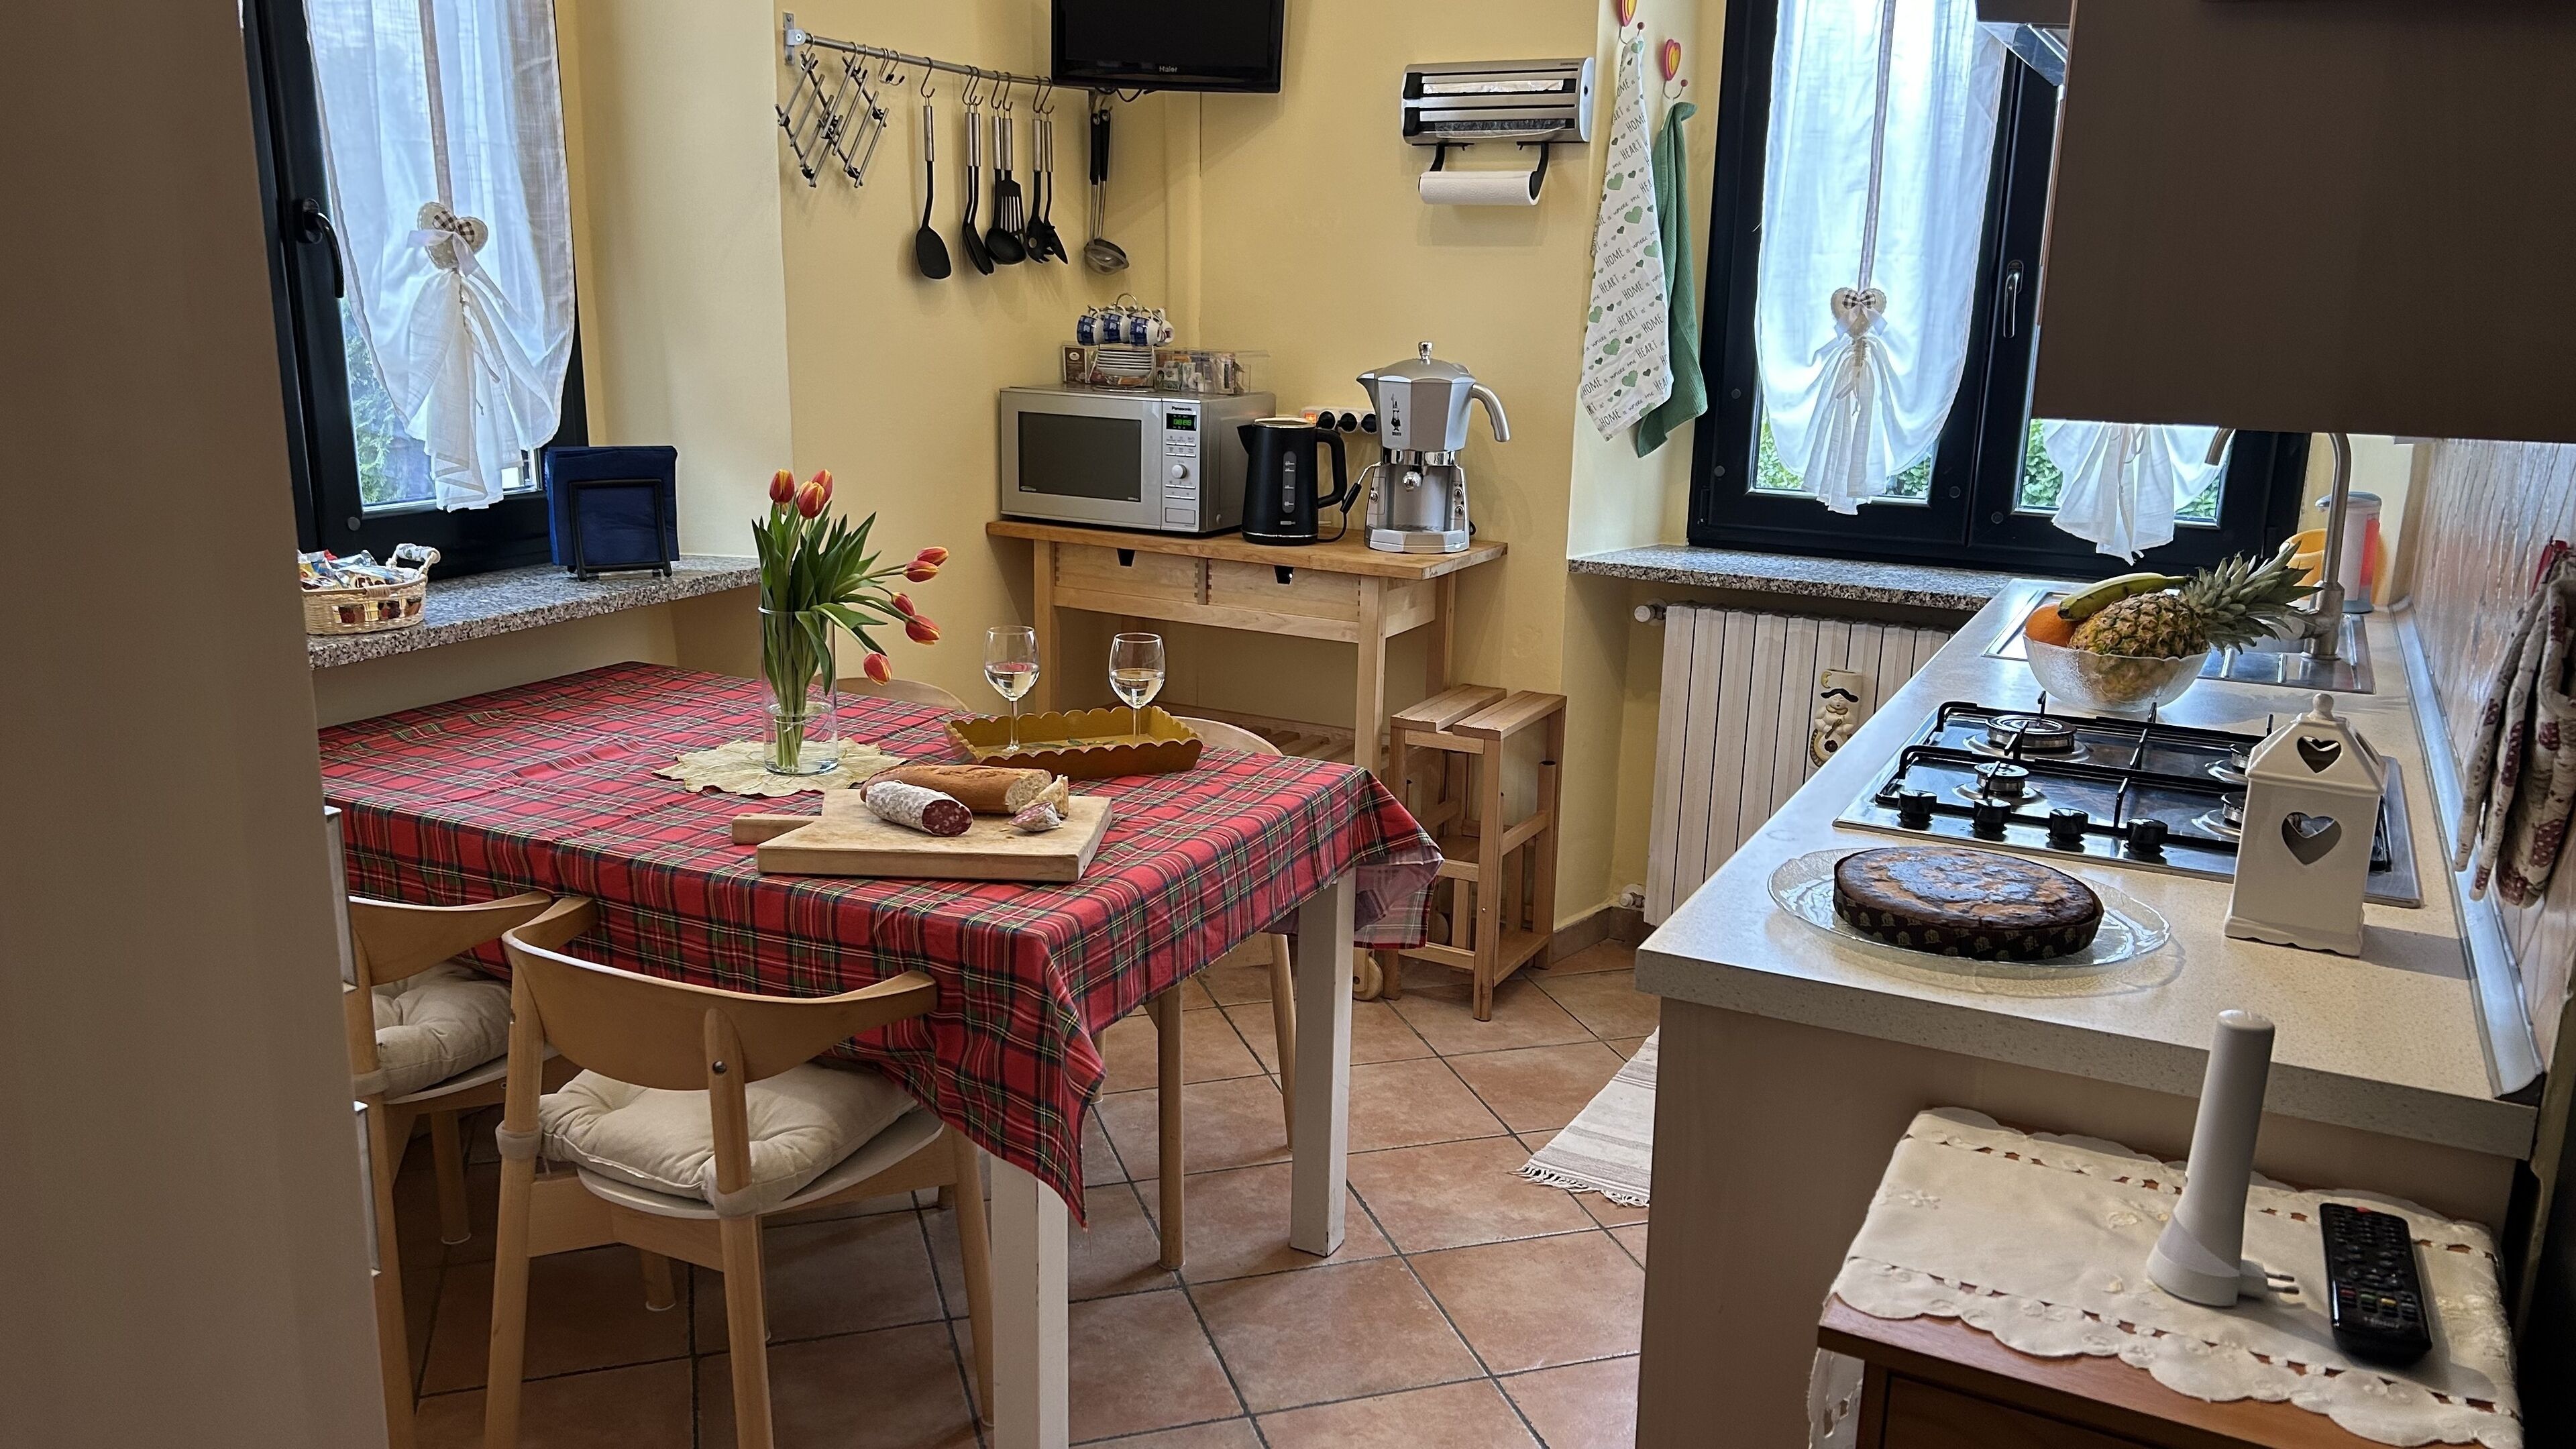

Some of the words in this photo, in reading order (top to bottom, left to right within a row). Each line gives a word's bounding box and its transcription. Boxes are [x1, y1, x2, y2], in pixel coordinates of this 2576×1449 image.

[1619, 138, 1642, 160] HEART
[1603, 246, 1625, 268] HOME
[1599, 273, 1620, 294] HEART
[1621, 280, 1644, 301] HOME
[1616, 307, 1639, 328] HEART
[1641, 313, 1664, 334] HOME
[1581, 376, 1603, 396] HOME
[1635, 339, 1658, 360] HEART
[1599, 408, 1622, 429] HOME
